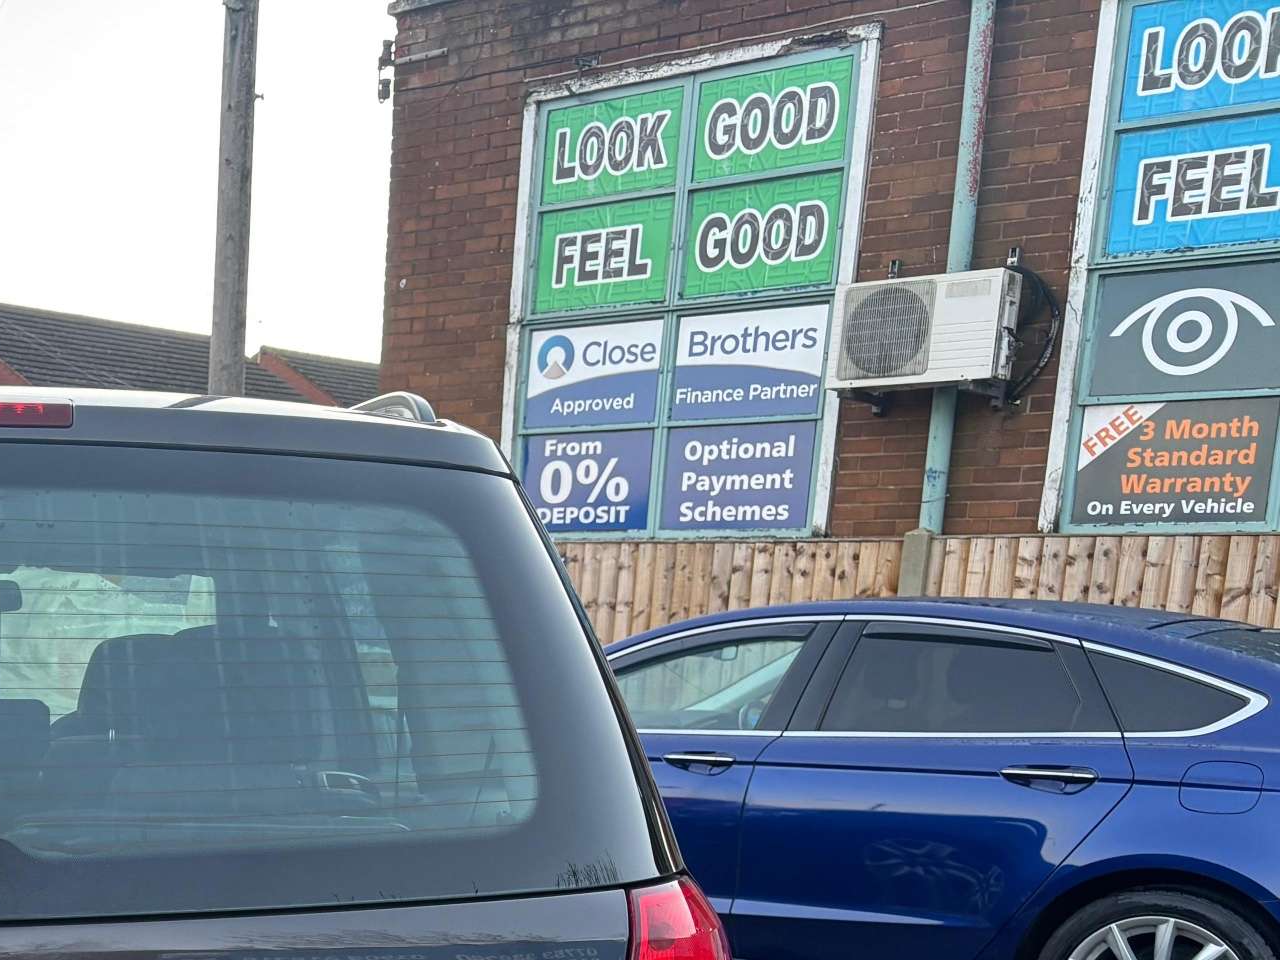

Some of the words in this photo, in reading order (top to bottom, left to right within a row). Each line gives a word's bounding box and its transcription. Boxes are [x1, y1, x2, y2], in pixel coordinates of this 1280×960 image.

[704, 81, 840, 161] GOOD
[553, 110, 671, 184] LOOK
[1132, 144, 1280, 226] FEEL
[695, 200, 828, 273] GOOD
[552, 223, 653, 288] FEEL
[582, 340, 657, 367] Close
[688, 326, 818, 357] Brothers
[550, 393, 635, 415] Approved
[675, 386, 744, 404] Finance
[749, 382, 818, 400] Partner
[1082, 405, 1144, 458] FREE
[1139, 420, 1157, 441] 3
[1164, 416, 1260, 440] Month
[543, 438, 603, 457] From
[684, 435, 796, 465] Optional
[1126, 443, 1257, 468] Standard
[539, 457, 629, 504] 0%
[681, 468, 794, 496] Payment
[1120, 472, 1253, 497] Warranty
[537, 505, 631, 525] DEPOSIT
[679, 500, 790, 523] Schemes
[1086, 501, 1114, 516] On
[1120, 499, 1175, 517] Every
[1181, 497, 1255, 515] Vehicle
